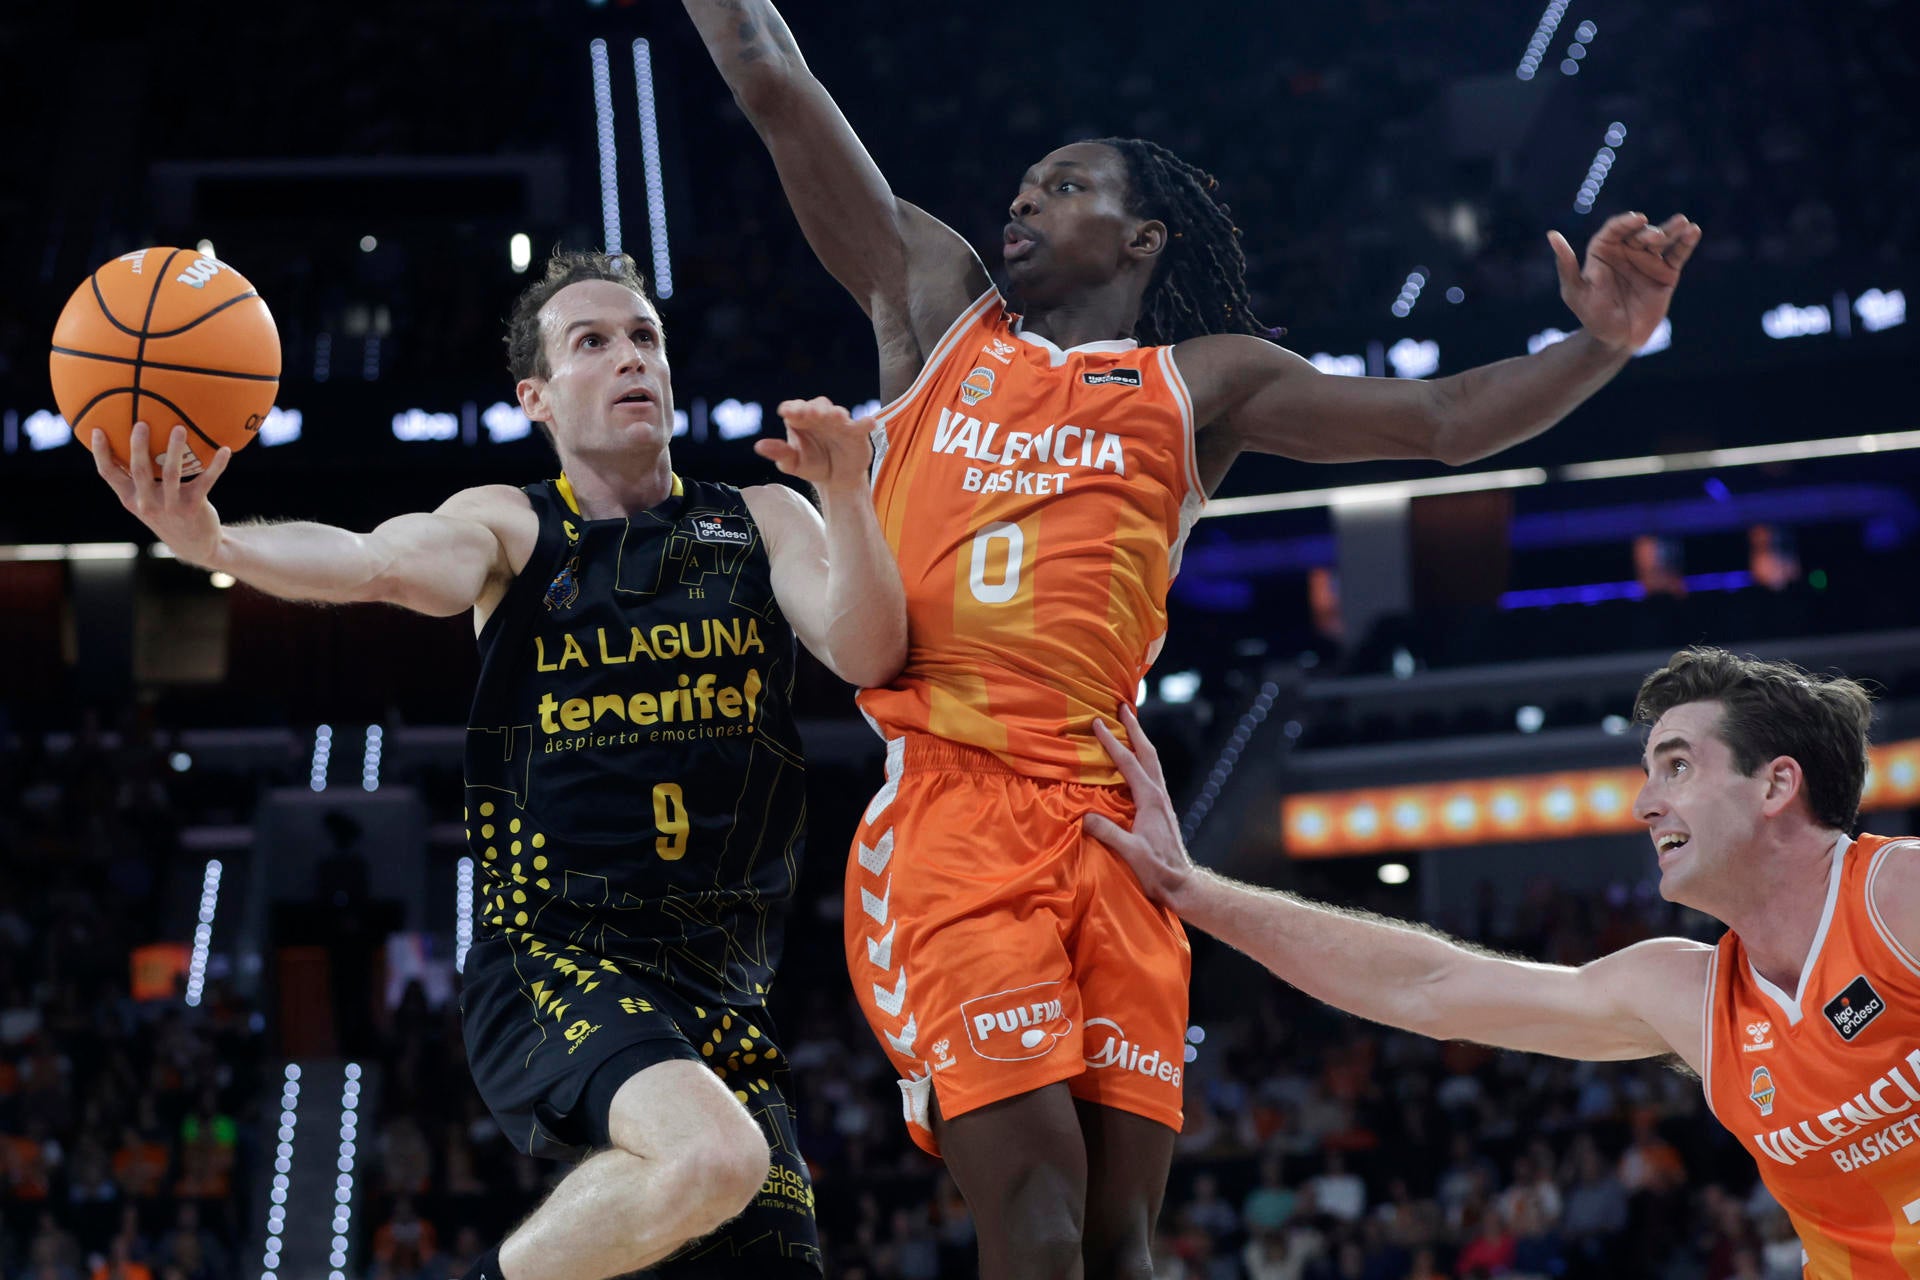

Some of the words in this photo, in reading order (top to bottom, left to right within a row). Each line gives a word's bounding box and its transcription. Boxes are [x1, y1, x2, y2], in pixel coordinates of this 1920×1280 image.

[931, 406, 1126, 478] VALENCIA
[961, 466, 1070, 495] BASKET
[699, 520, 722, 530] liga
[702, 529, 748, 540] endesa
[969, 520, 1024, 604] 0
[534, 633, 590, 673] LA
[597, 618, 765, 665] LAGUNA
[545, 731, 639, 754] despierta
[649, 722, 743, 742] emociones
[652, 782, 690, 861] 9
[1834, 1006, 1854, 1026] liga
[1842, 998, 1880, 1034] endesa
[1083, 1035, 1182, 1089] Midea
[768, 1164, 804, 1189] slas
